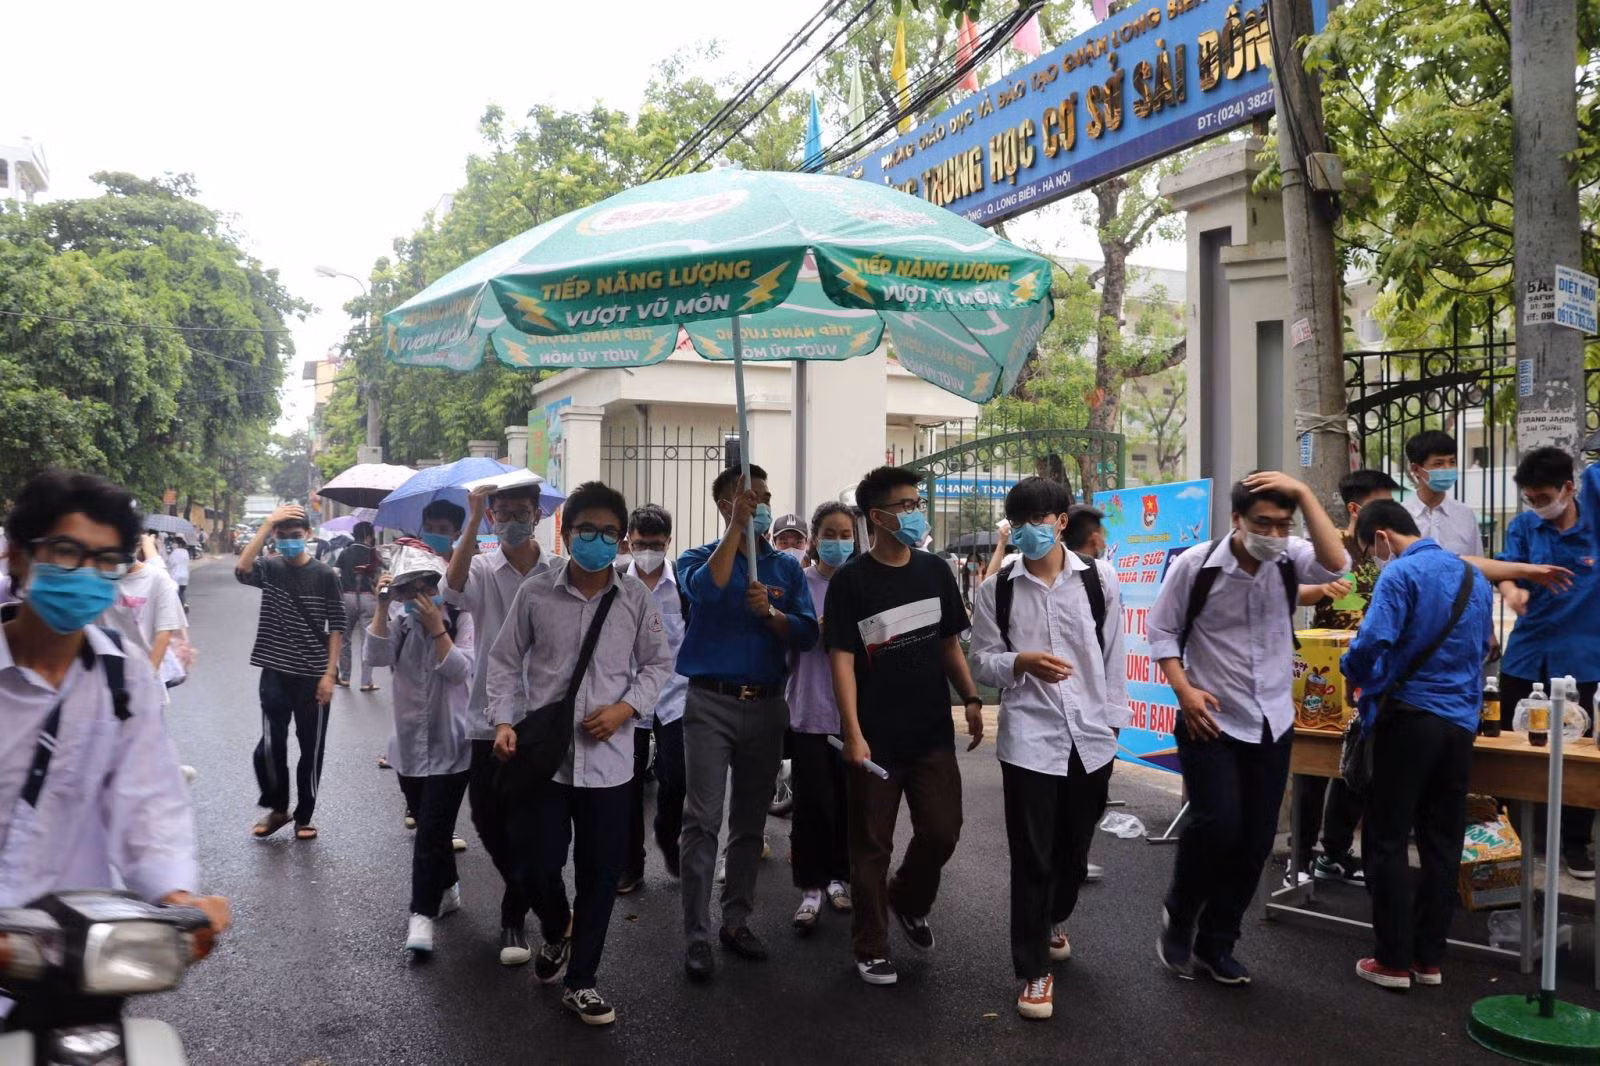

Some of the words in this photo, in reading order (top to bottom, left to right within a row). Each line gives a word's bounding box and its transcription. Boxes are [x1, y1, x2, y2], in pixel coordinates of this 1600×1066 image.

[950, 108, 975, 136] DỤC
[977, 95, 993, 118] VÀ
[1031, 64, 1059, 92] TẠO
[1112, 8, 1161, 49] LONG
[921, 145, 985, 208] TRUNG
[988, 118, 1036, 186] HỌC
[1042, 92, 1079, 159] CƠ
[1086, 52, 1125, 139] SỞ
[1132, 38, 1188, 119] SÀI
[1018, 185, 1037, 202] BIÊN
[1042, 177, 1055, 193] HÀ
[1056, 170, 1071, 187] NỘI
[541, 273, 591, 302] TIẾP
[596, 267, 663, 297] NĂNG
[668, 260, 752, 289] LƯỢNG
[853, 252, 892, 277] TIẾP
[895, 256, 950, 280] NĂNG
[951, 261, 1011, 284] LƯỢNG
[565, 304, 631, 328] VƯỢT
[636, 299, 669, 321] VŨ
[674, 292, 731, 316] MÔN
[882, 284, 928, 308] VƯỢT
[932, 288, 954, 305] VŨ
[957, 287, 1001, 305] MÔN
[981, 484, 1013, 495] TRAN
[1126, 649, 1150, 682] ÚNG
